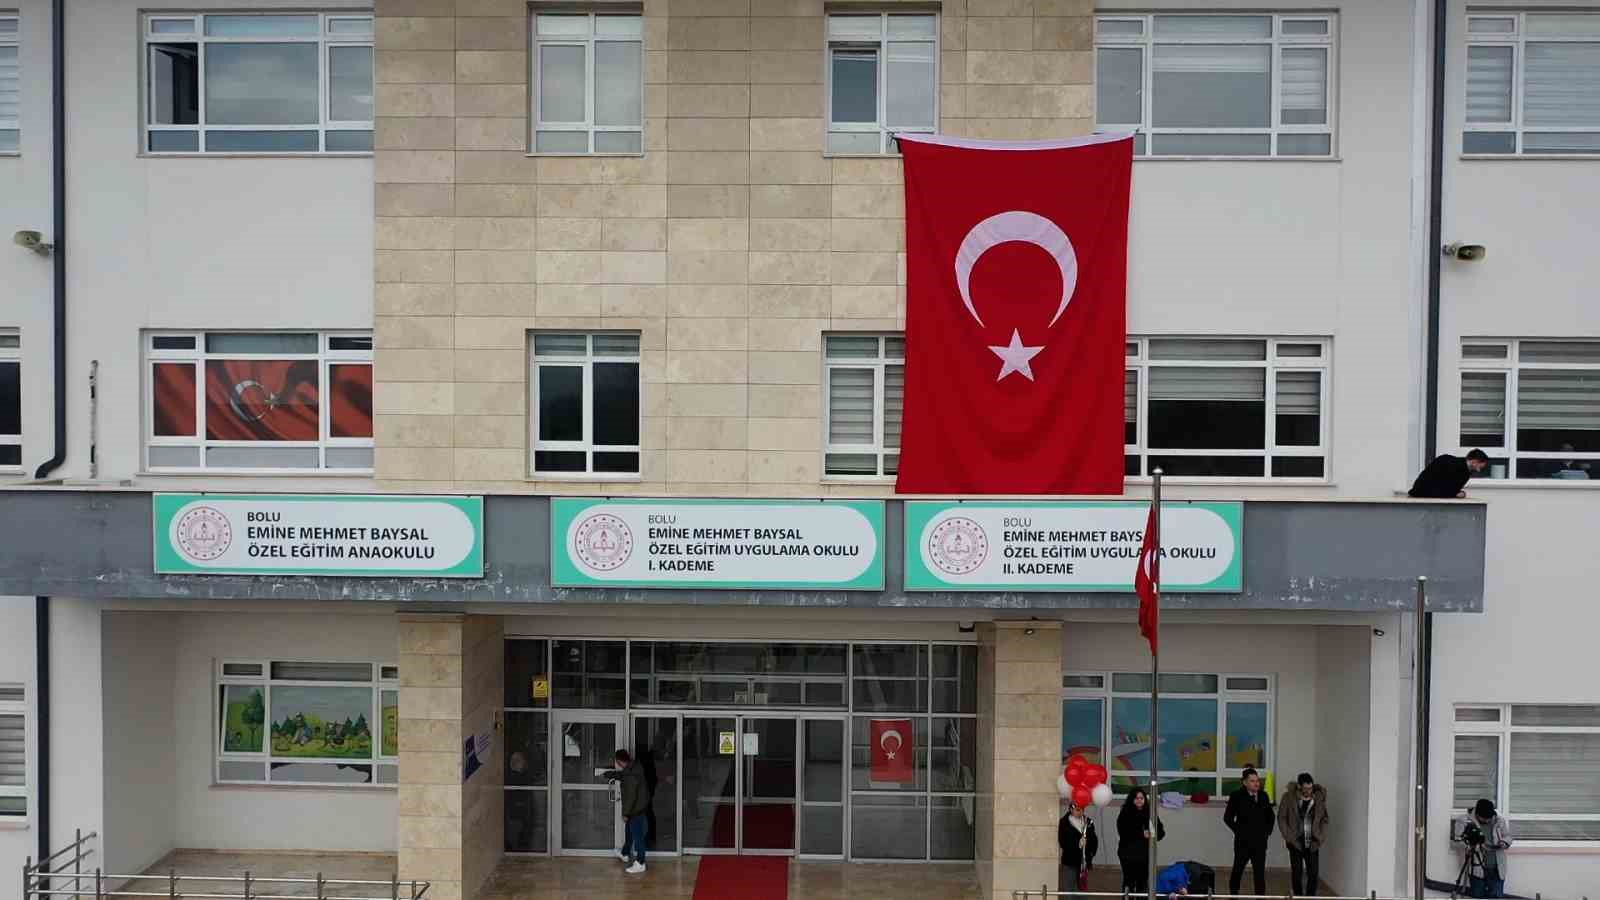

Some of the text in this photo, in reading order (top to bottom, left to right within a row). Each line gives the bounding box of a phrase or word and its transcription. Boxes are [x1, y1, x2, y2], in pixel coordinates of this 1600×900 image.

[248, 511, 281, 522] BOLU
[648, 514, 677, 525] BOLU
[1003, 517, 1032, 528] BOLU
[248, 524, 429, 541] EMİNE MEHMET BAYSAL
[649, 525, 804, 541] EMİNE MEHMET BAYSAL
[1004, 528, 1143, 543] EMİNE MEHMET BAYS
[248, 542, 435, 560] ÖZEL EĞİTİM ANAOKULU
[649, 540, 859, 557] ÖZEL EĞİTİM UYGULAMA OKULU
[1004, 544, 1039, 559] ÖZEL
[1041, 544, 1087, 560] EĞİTİM
[1170, 547, 1216, 559] OKULU
[649, 560, 715, 572] I. KADEME
[1003, 563, 1074, 575] II. KADEME
